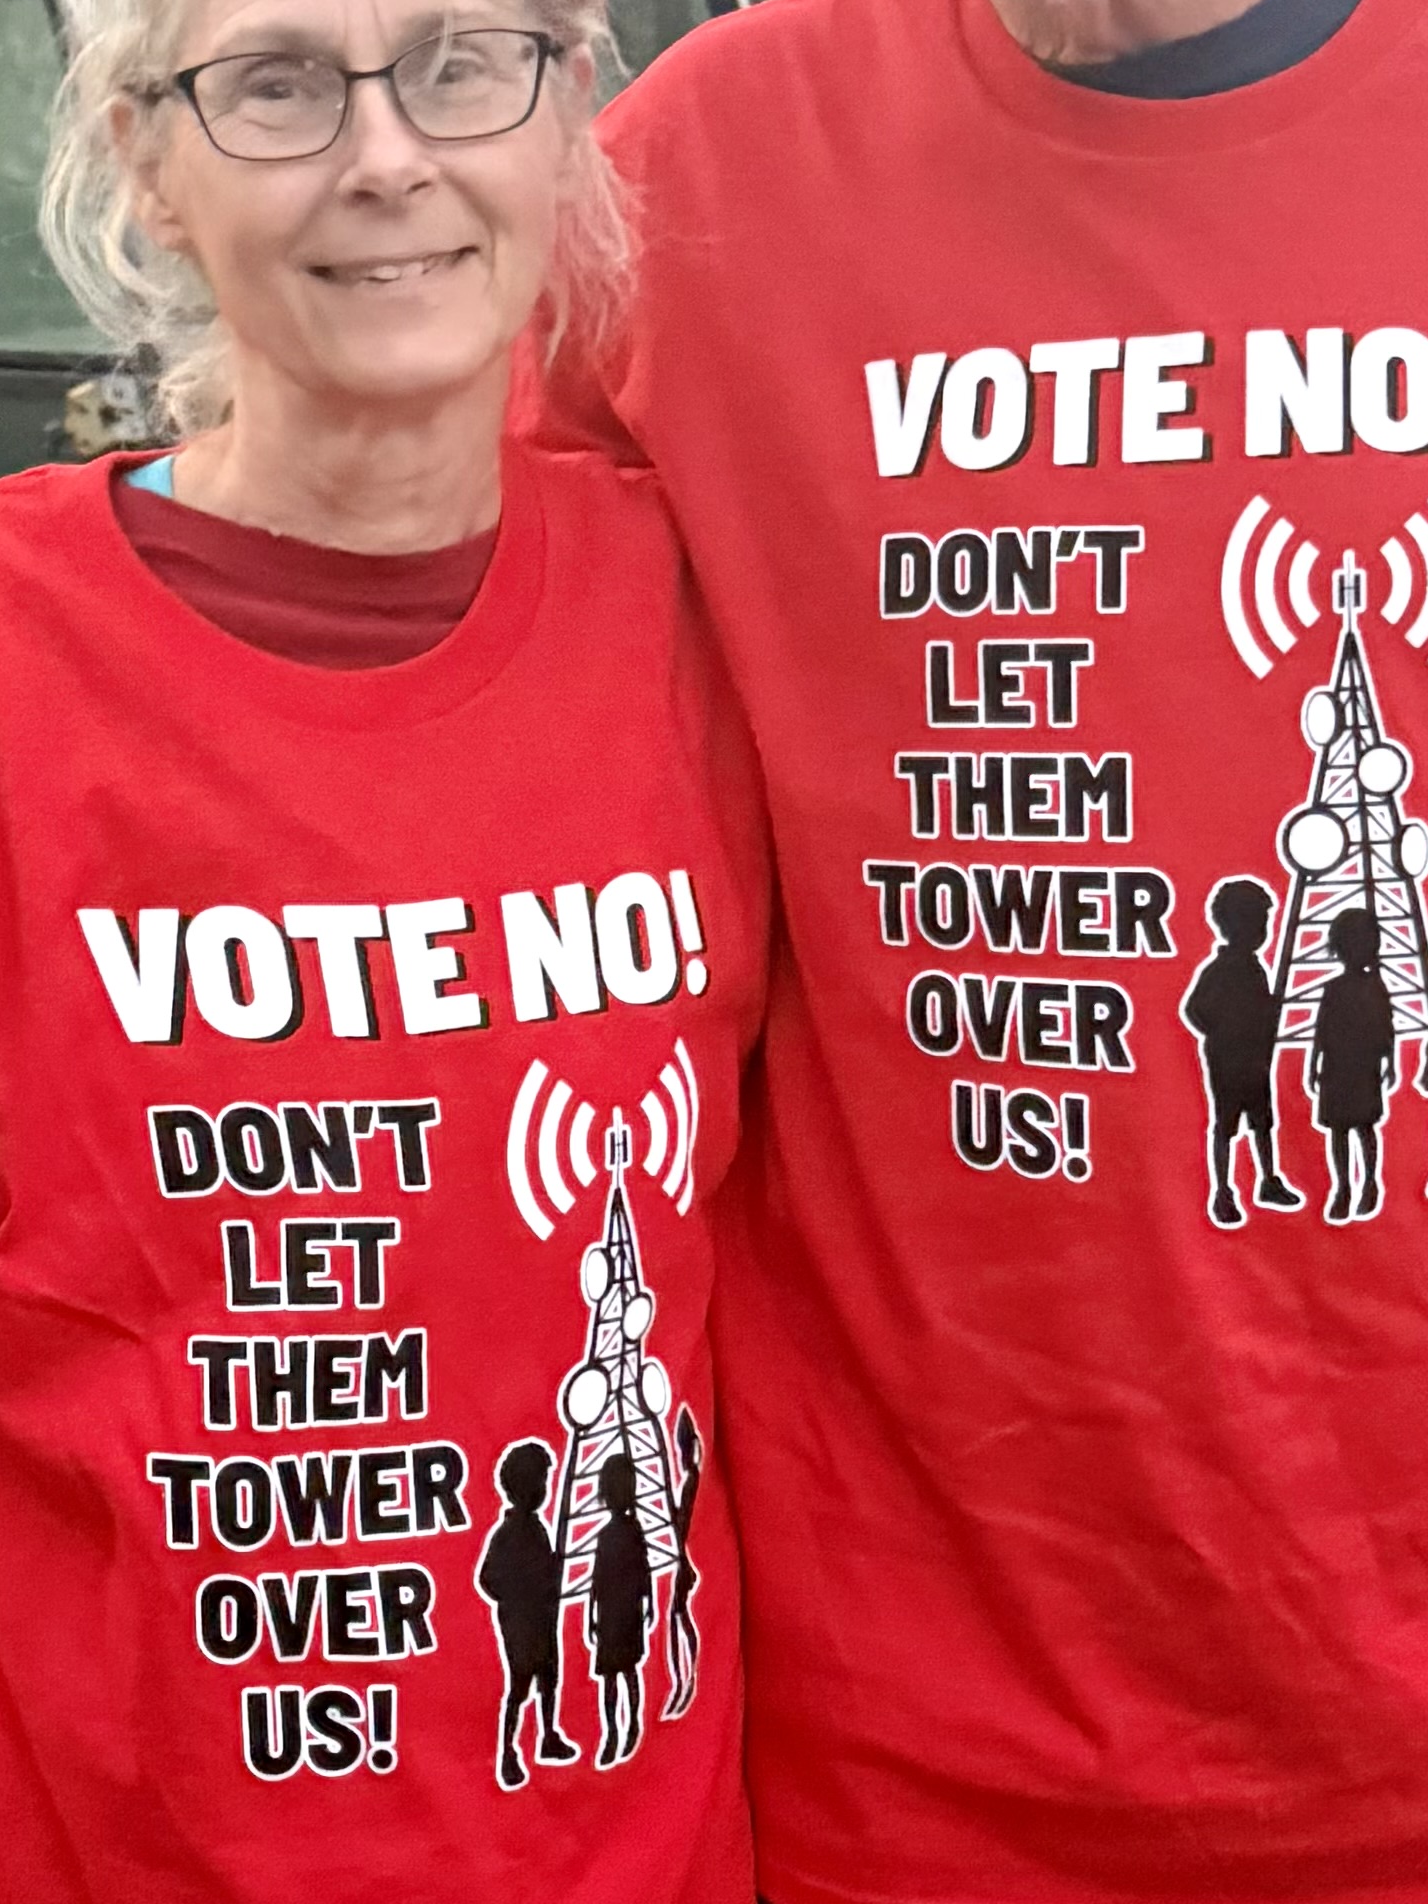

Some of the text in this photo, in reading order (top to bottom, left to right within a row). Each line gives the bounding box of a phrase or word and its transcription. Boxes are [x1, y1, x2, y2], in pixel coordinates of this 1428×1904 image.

[864, 331, 1213, 477] VOTE
[880, 525, 1145, 619] DON'T
[926, 638, 1094, 728] LET
[895, 752, 1132, 843] THEM
[78, 870, 707, 1044] VOTE NO!
[863, 860, 1177, 958] TOWER
[907, 970, 1135, 1073] OVER
[148, 1098, 441, 1198] DON'T
[952, 1080, 1092, 1182] US!
[221, 1217, 400, 1312] LET
[188, 1329, 428, 1432] THEM
[147, 1442, 471, 1551] TOWER
[196, 1562, 437, 1665] OVER
[241, 1684, 397, 1781] US!
